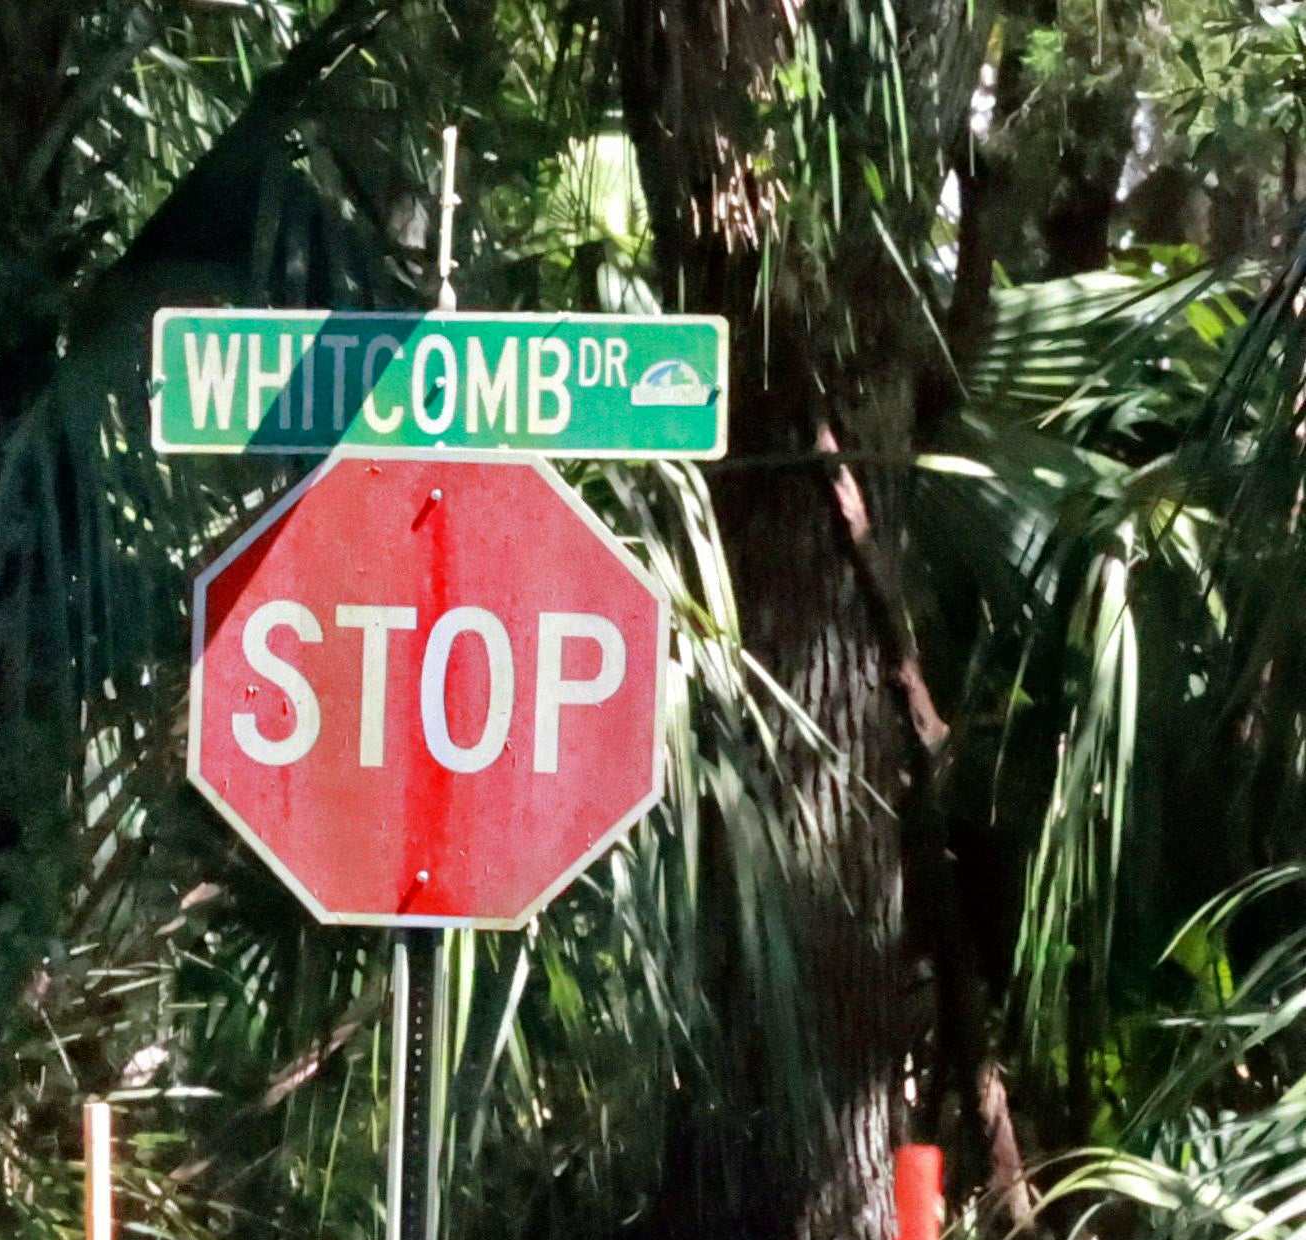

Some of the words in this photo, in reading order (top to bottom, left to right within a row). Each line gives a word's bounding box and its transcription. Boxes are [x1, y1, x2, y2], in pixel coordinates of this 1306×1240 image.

[183, 332, 572, 435] WHITCOMB
[578, 337, 629, 387] DR
[231, 600, 627, 774] STOP
